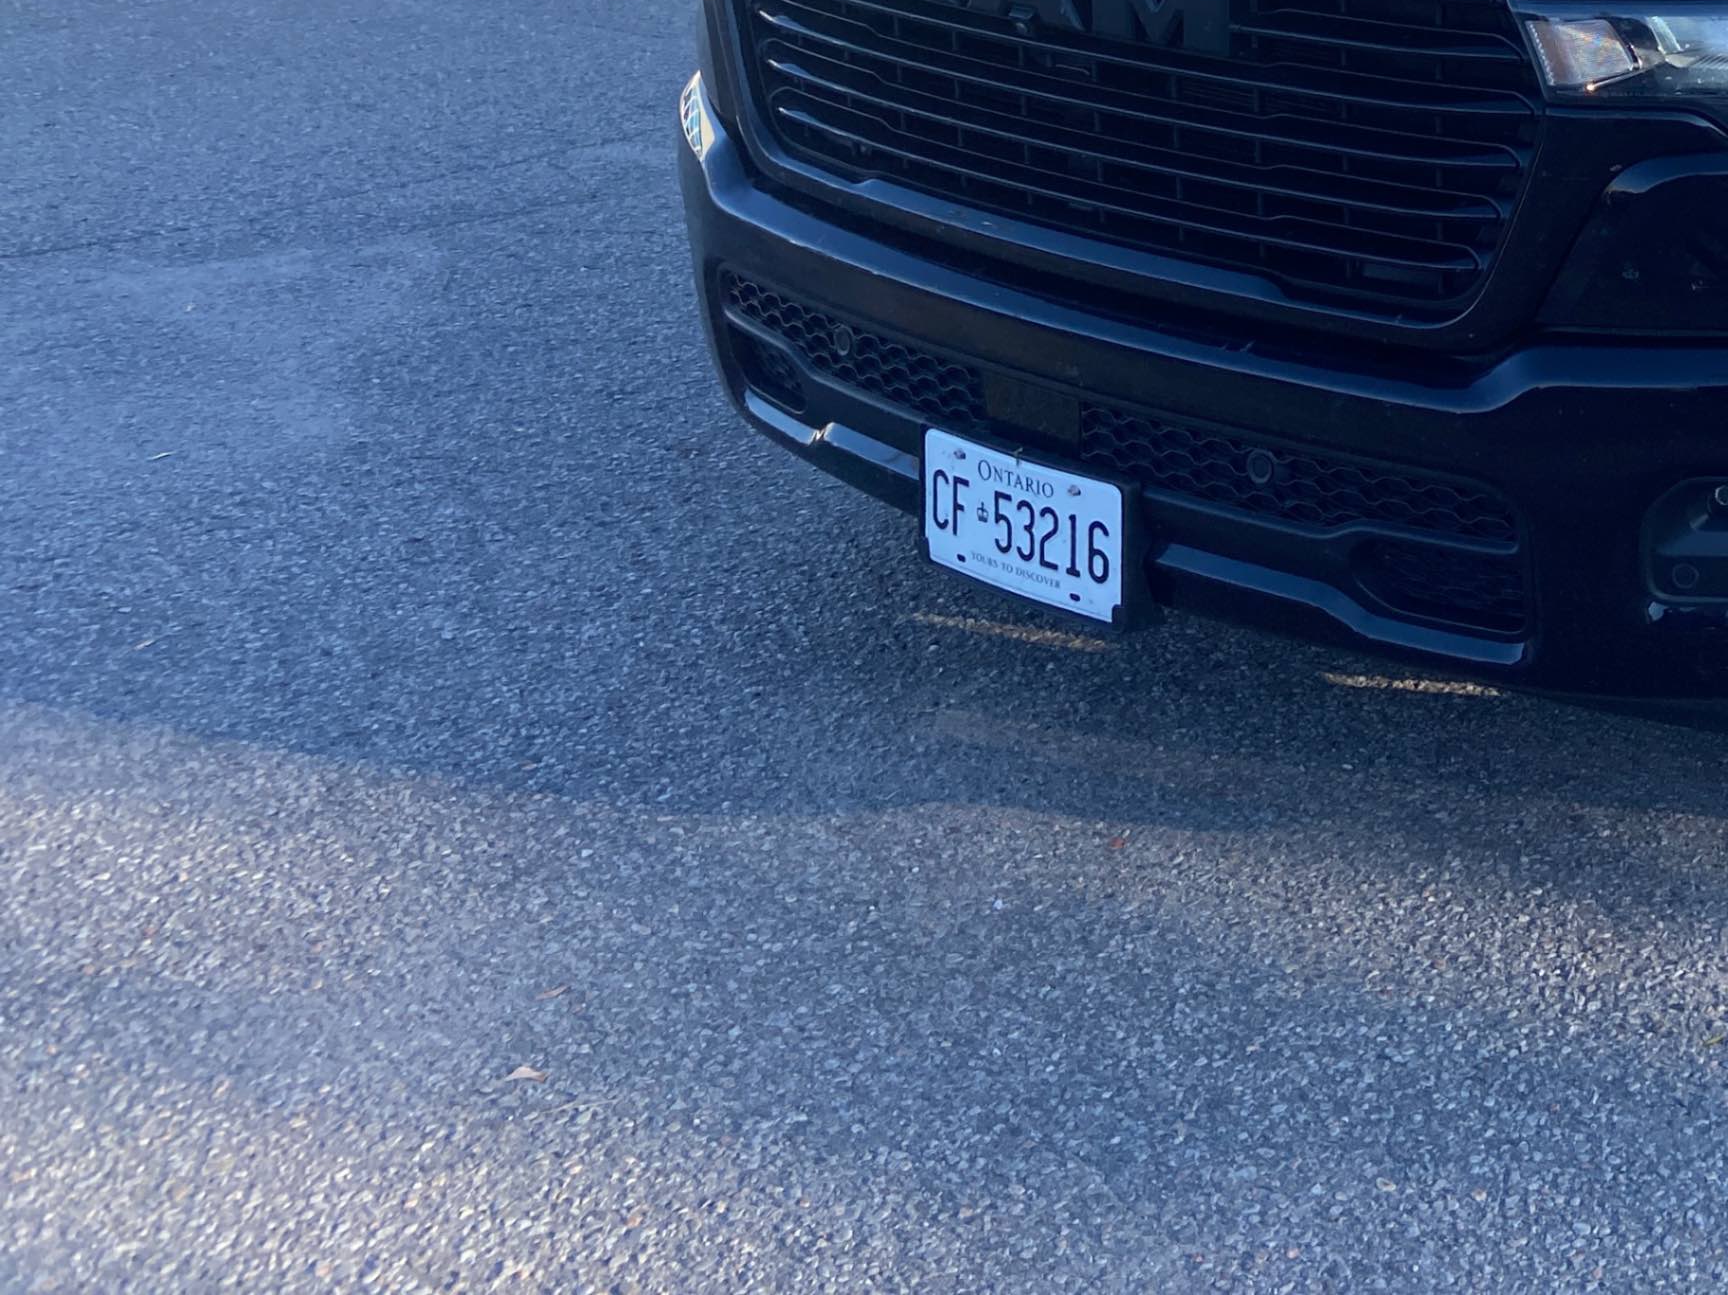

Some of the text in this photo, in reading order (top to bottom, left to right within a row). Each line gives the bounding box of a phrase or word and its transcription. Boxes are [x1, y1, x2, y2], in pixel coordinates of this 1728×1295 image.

[977, 459, 1054, 498] ONTARIO
[932, 469, 1110, 584] CF 53216
[971, 552, 1061, 589] YOURS TO DISCOVER
